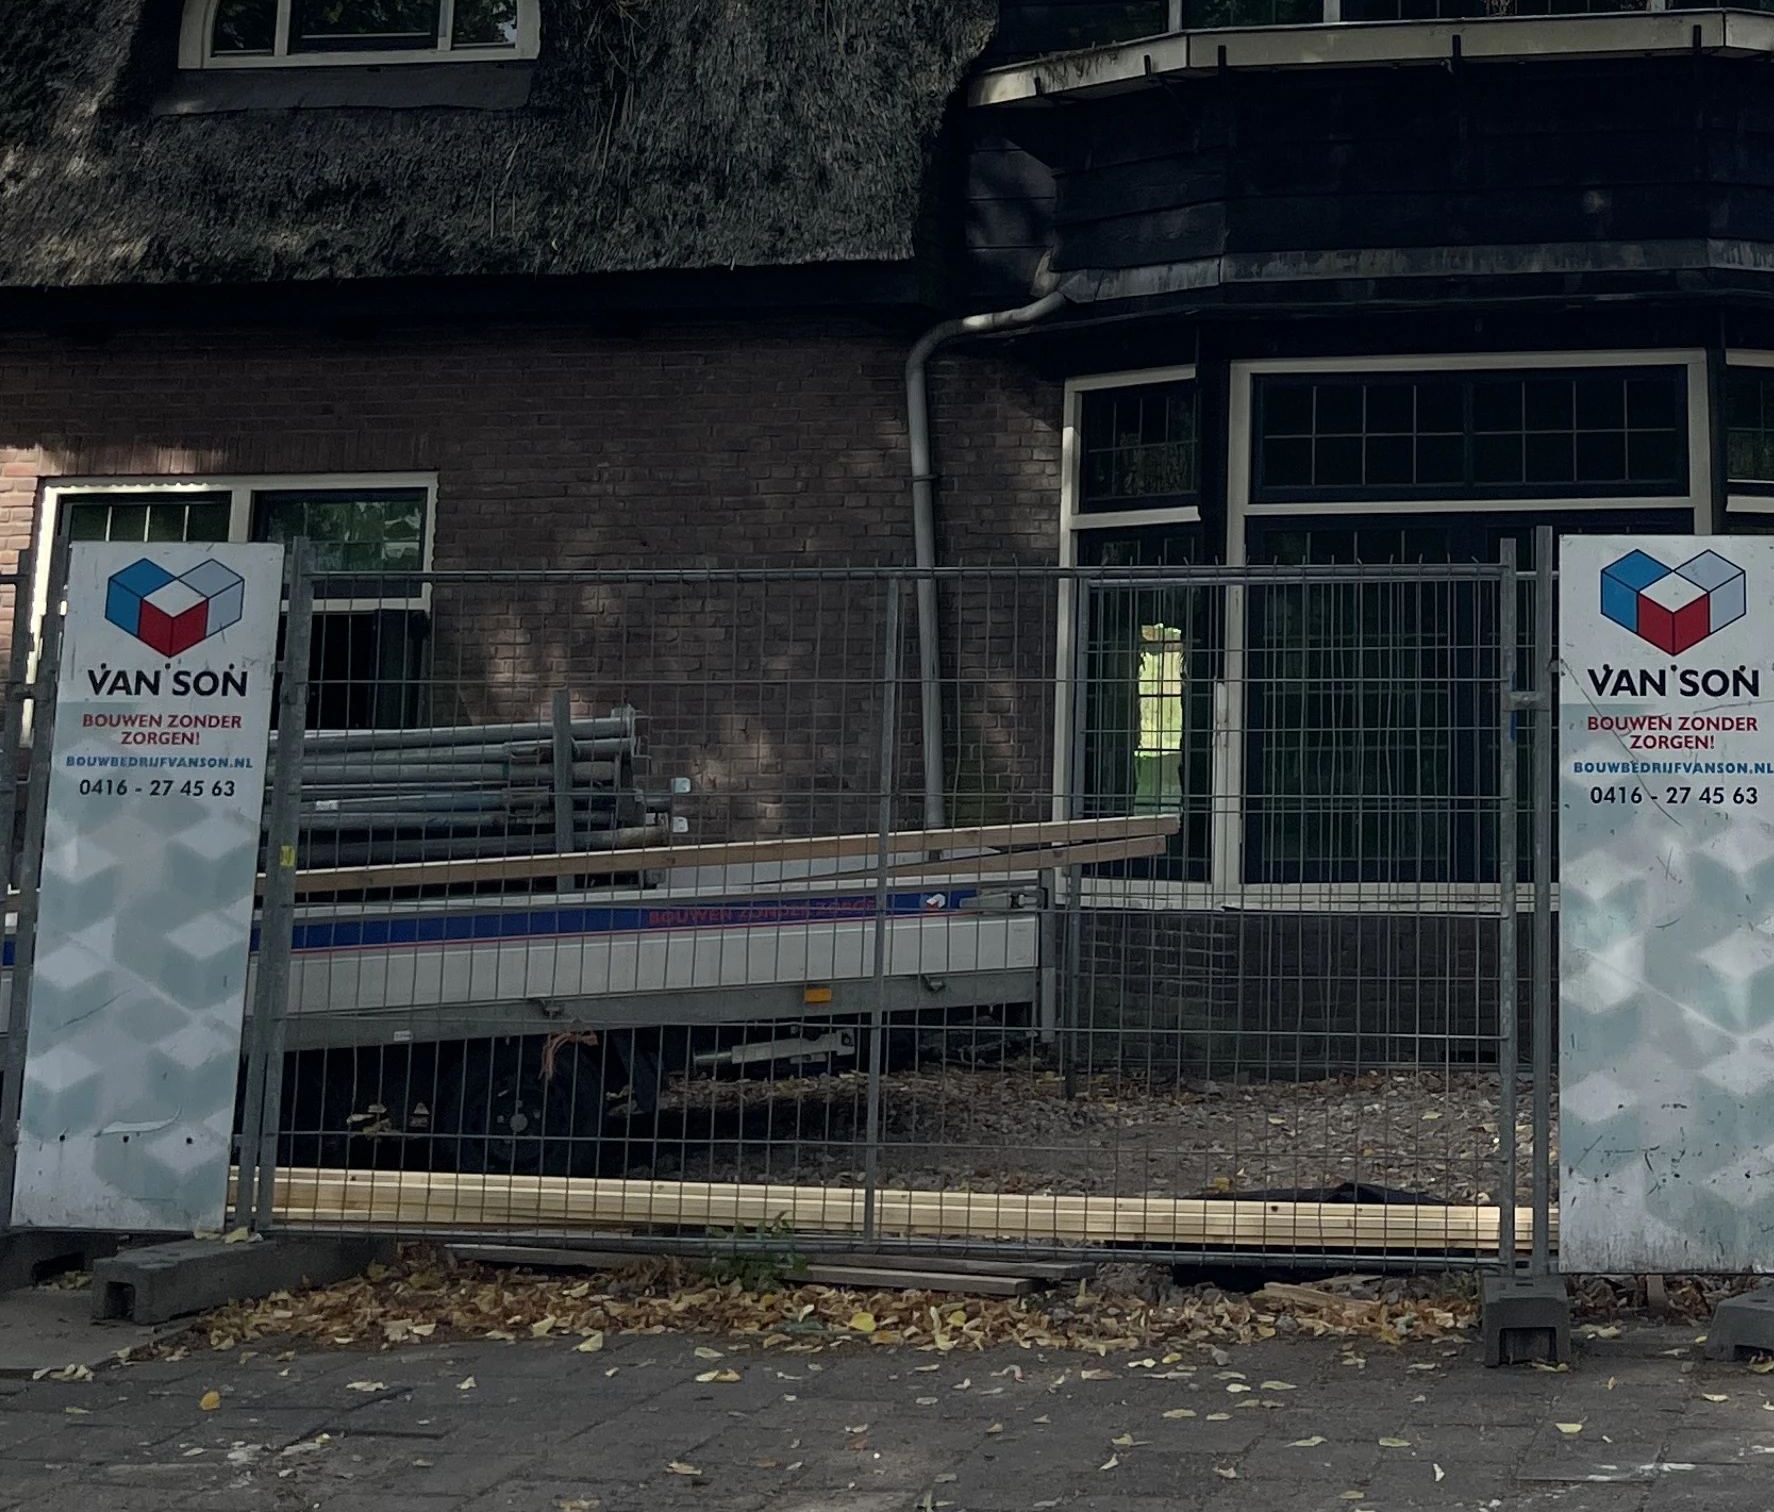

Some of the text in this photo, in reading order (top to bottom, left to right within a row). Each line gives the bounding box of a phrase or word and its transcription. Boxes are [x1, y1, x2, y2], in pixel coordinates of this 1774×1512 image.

[88, 669, 248, 697] VAN SON
[1587, 669, 1760, 697] VAN SON
[82, 714, 242, 729] BOUWEN ZONDER
[1587, 715, 1758, 731] BOUWEN ZONDER
[121, 731, 200, 746] ZORGEN!
[1630, 735, 1715, 750] ZORGEN!
[66, 755, 253, 769] BOUWBEDRIJFVANSON.NL
[1573, 762, 1774, 774] BOUWBEDRIJFVANSON.NL
[79, 779, 128, 796] 0416
[150, 780, 174, 797] 27
[180, 780, 204, 797] 45
[211, 780, 235, 797] 63
[1590, 787, 1643, 804] 0416
[1666, 787, 1691, 804] 27
[1699, 787, 1724, 804] 45
[1732, 787, 1758, 804] 63
[816, 899, 877, 915] ZORGE
